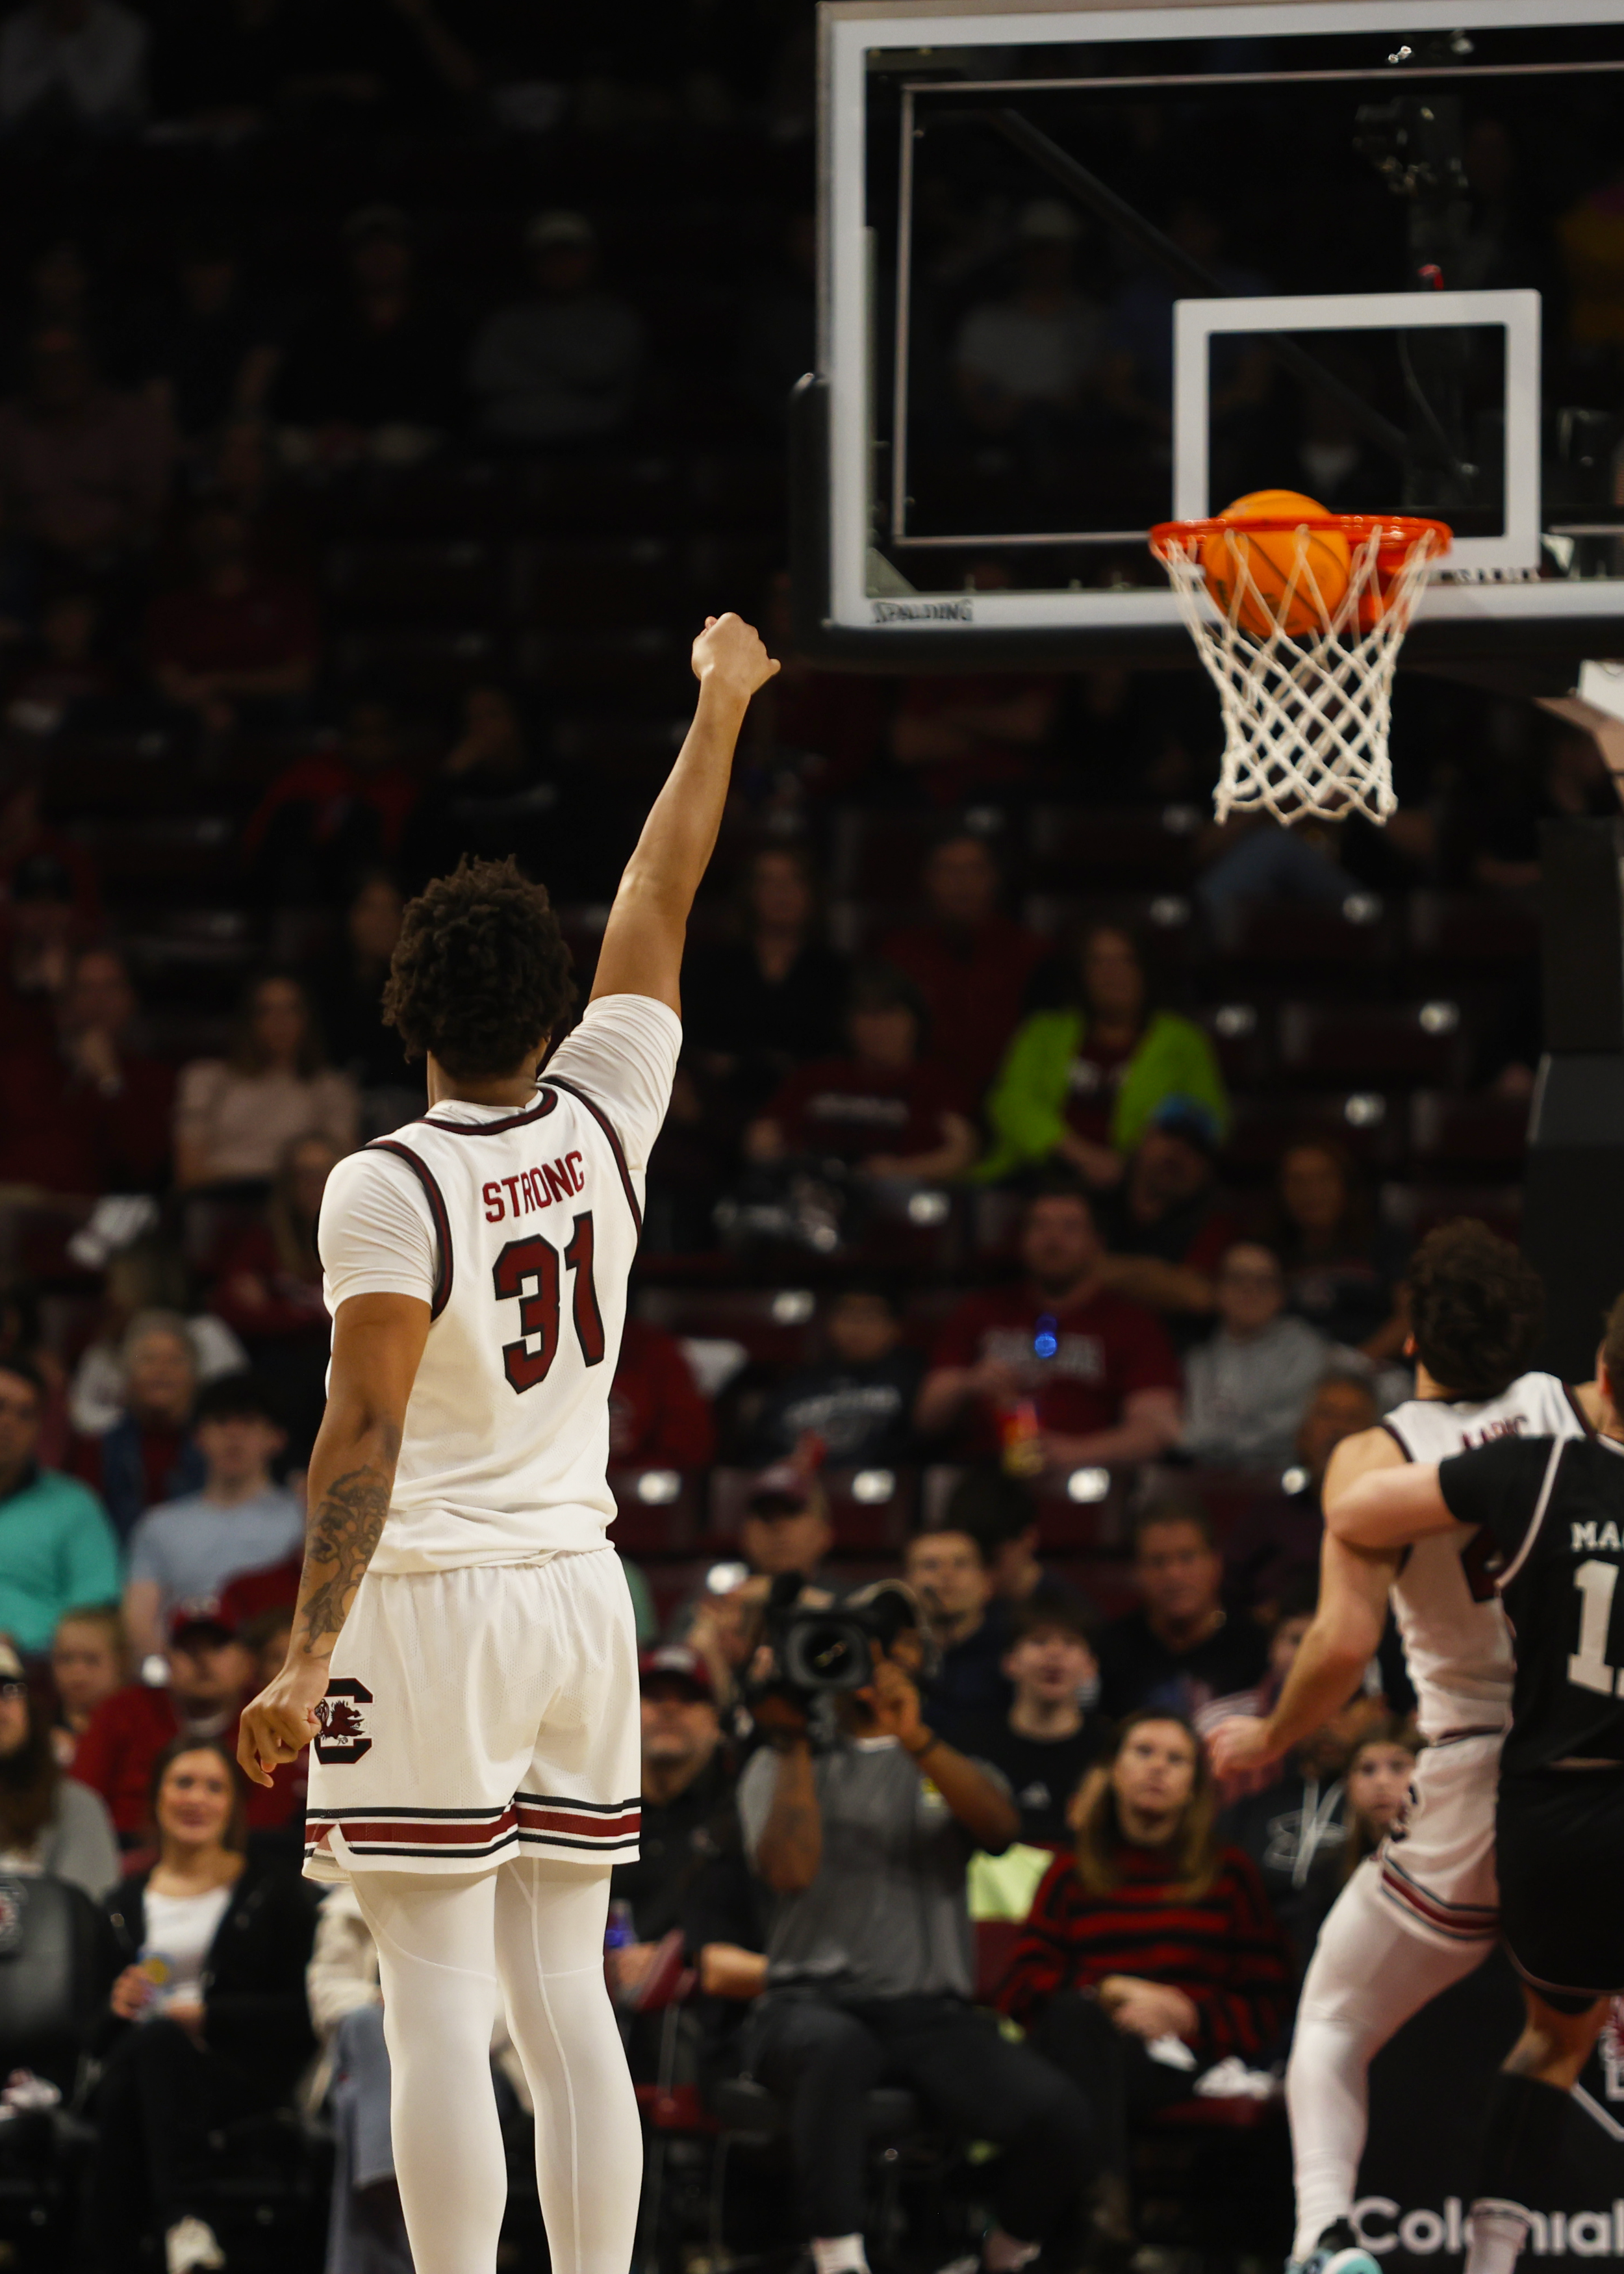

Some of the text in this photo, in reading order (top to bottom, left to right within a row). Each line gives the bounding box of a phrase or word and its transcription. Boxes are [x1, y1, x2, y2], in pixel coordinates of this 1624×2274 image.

[873, 598, 973, 623] SPALDING
[482, 1149, 585, 1223] STRONG
[492, 1209, 605, 1395] 31
[1571, 1520, 1624, 1552] MA
[1566, 1558, 1624, 1701] 1
[1349, 2195, 1624, 2257] Colnial
